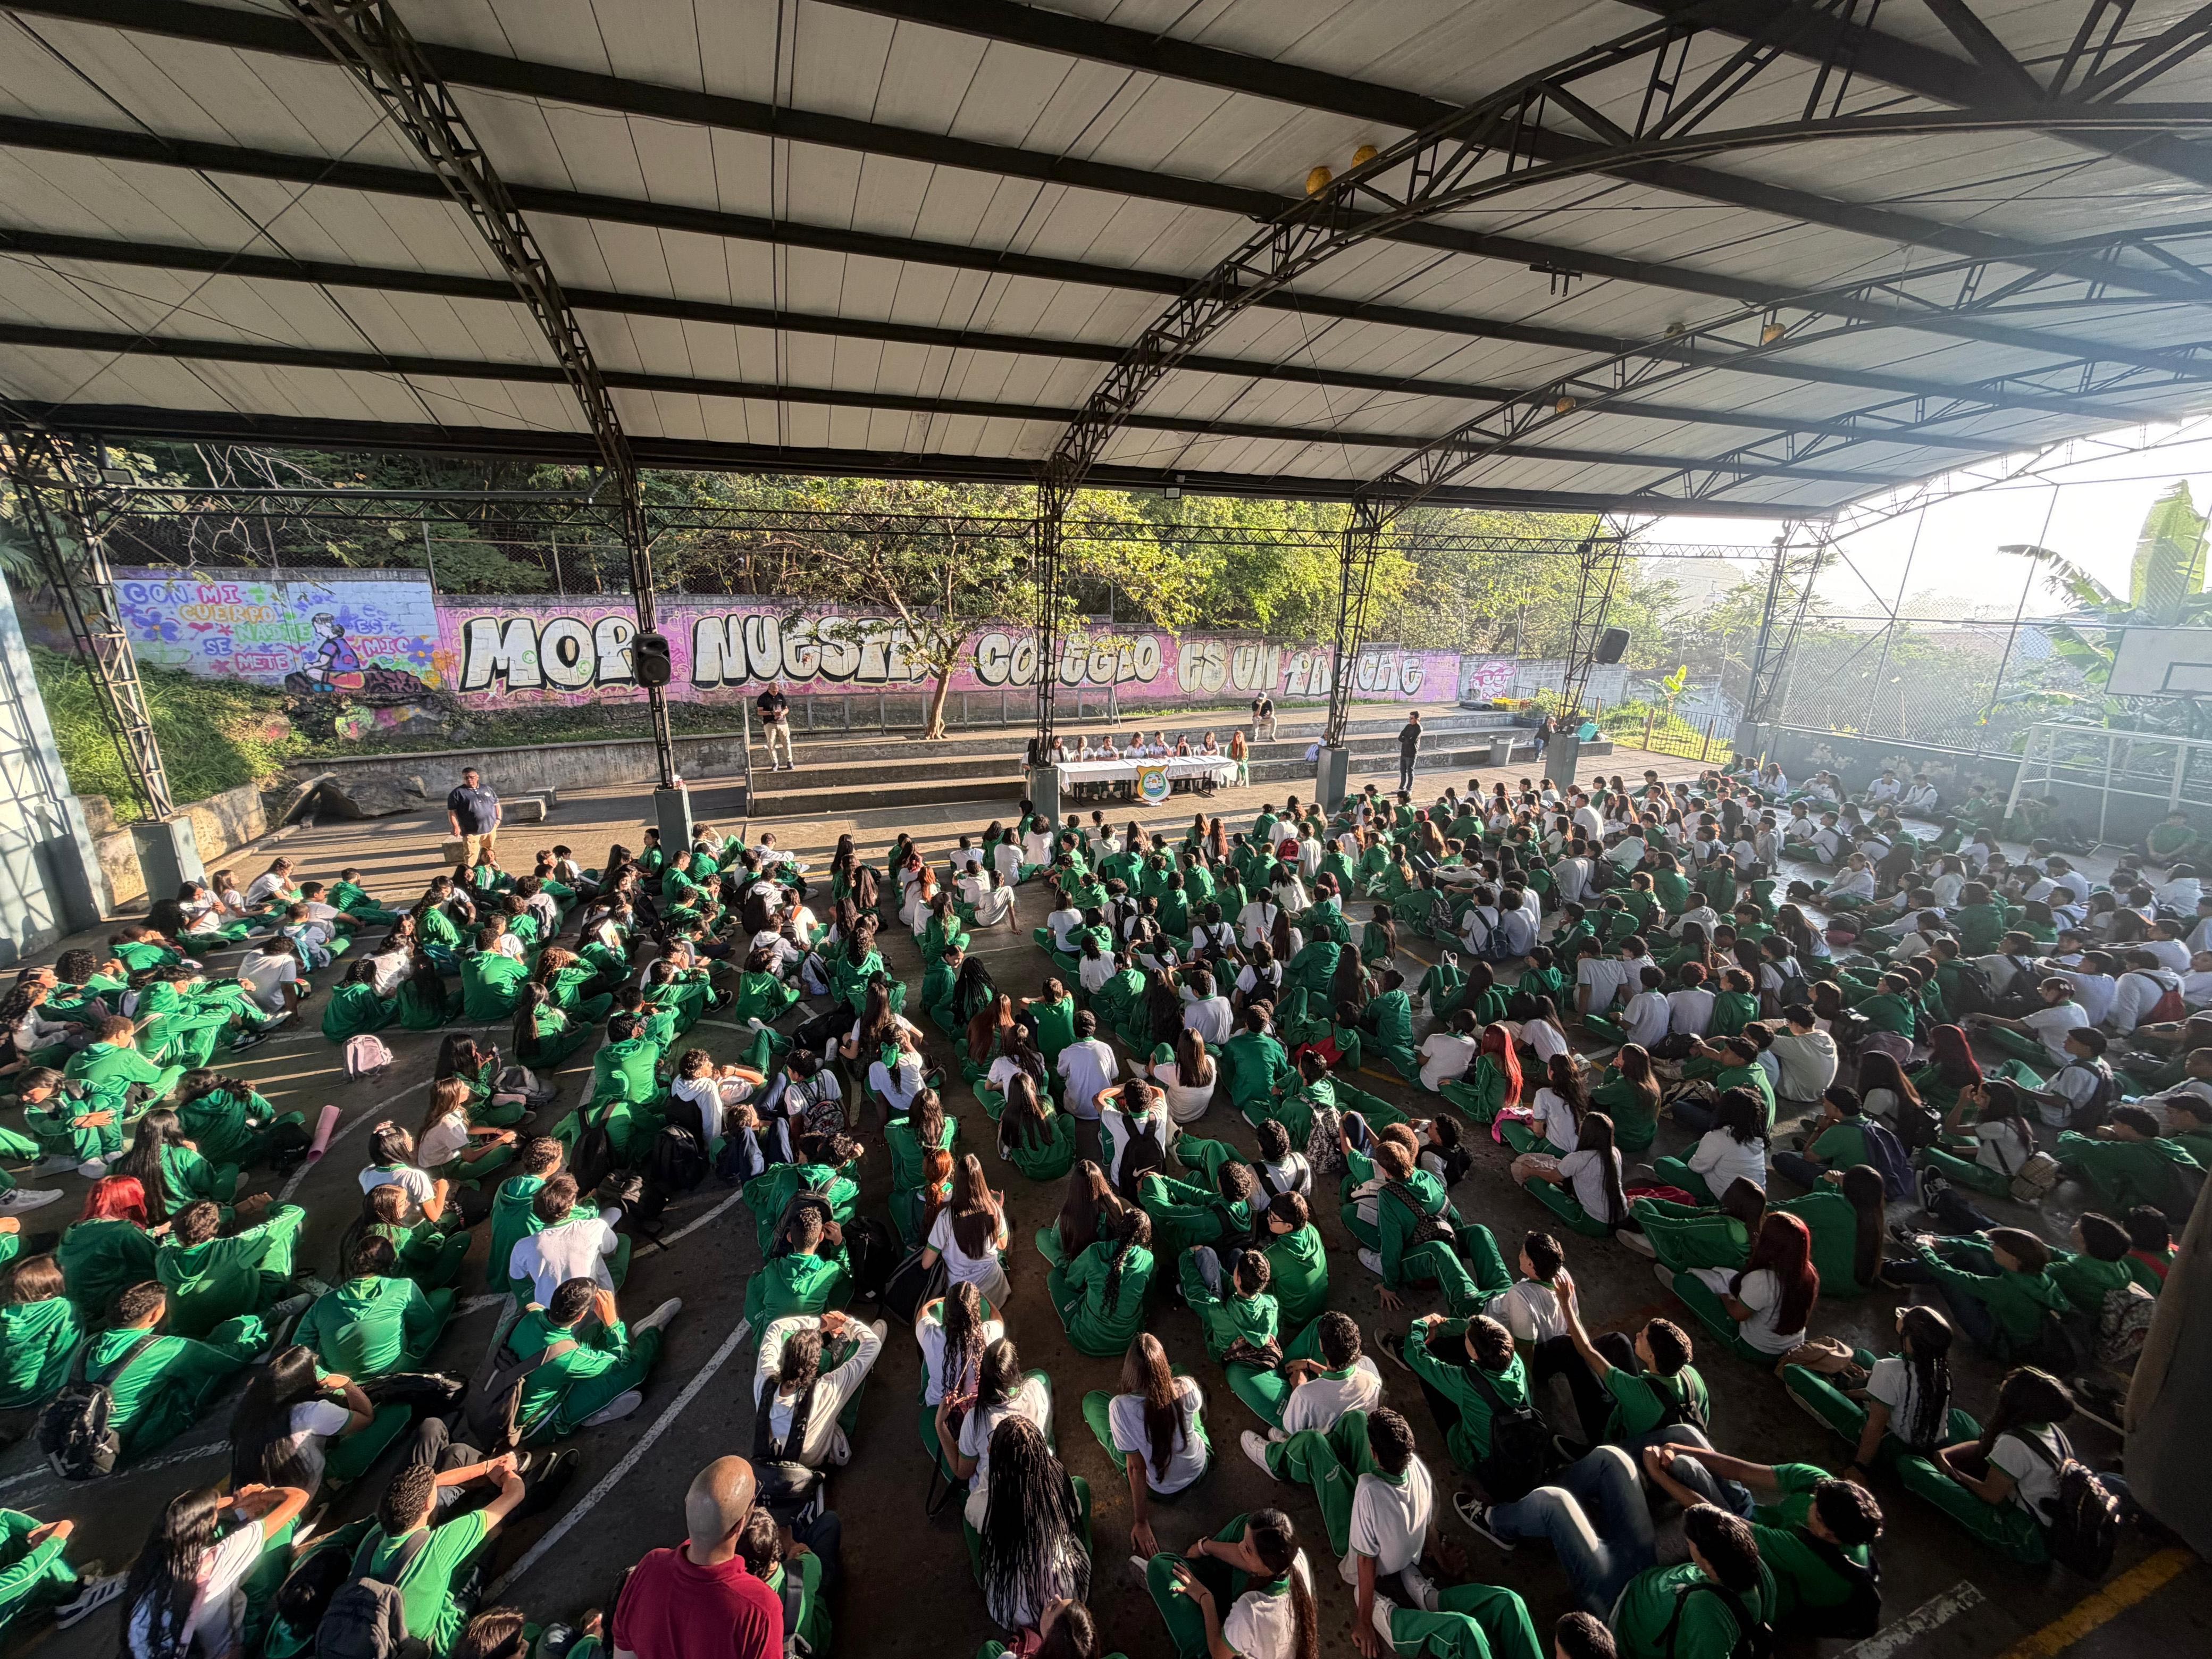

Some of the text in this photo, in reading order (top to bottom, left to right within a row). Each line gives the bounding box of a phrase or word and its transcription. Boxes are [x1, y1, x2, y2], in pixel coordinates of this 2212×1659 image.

[123, 583, 242, 606] CON MI
[179, 604, 275, 624] CUERPO
[234, 623, 313, 642] NADIE
[355, 619, 383, 634] ES
[203, 638, 233, 656] SE
[235, 652, 290, 672] METE
[1177, 641, 1228, 693] ES
[1231, 645, 1280, 691] UN
